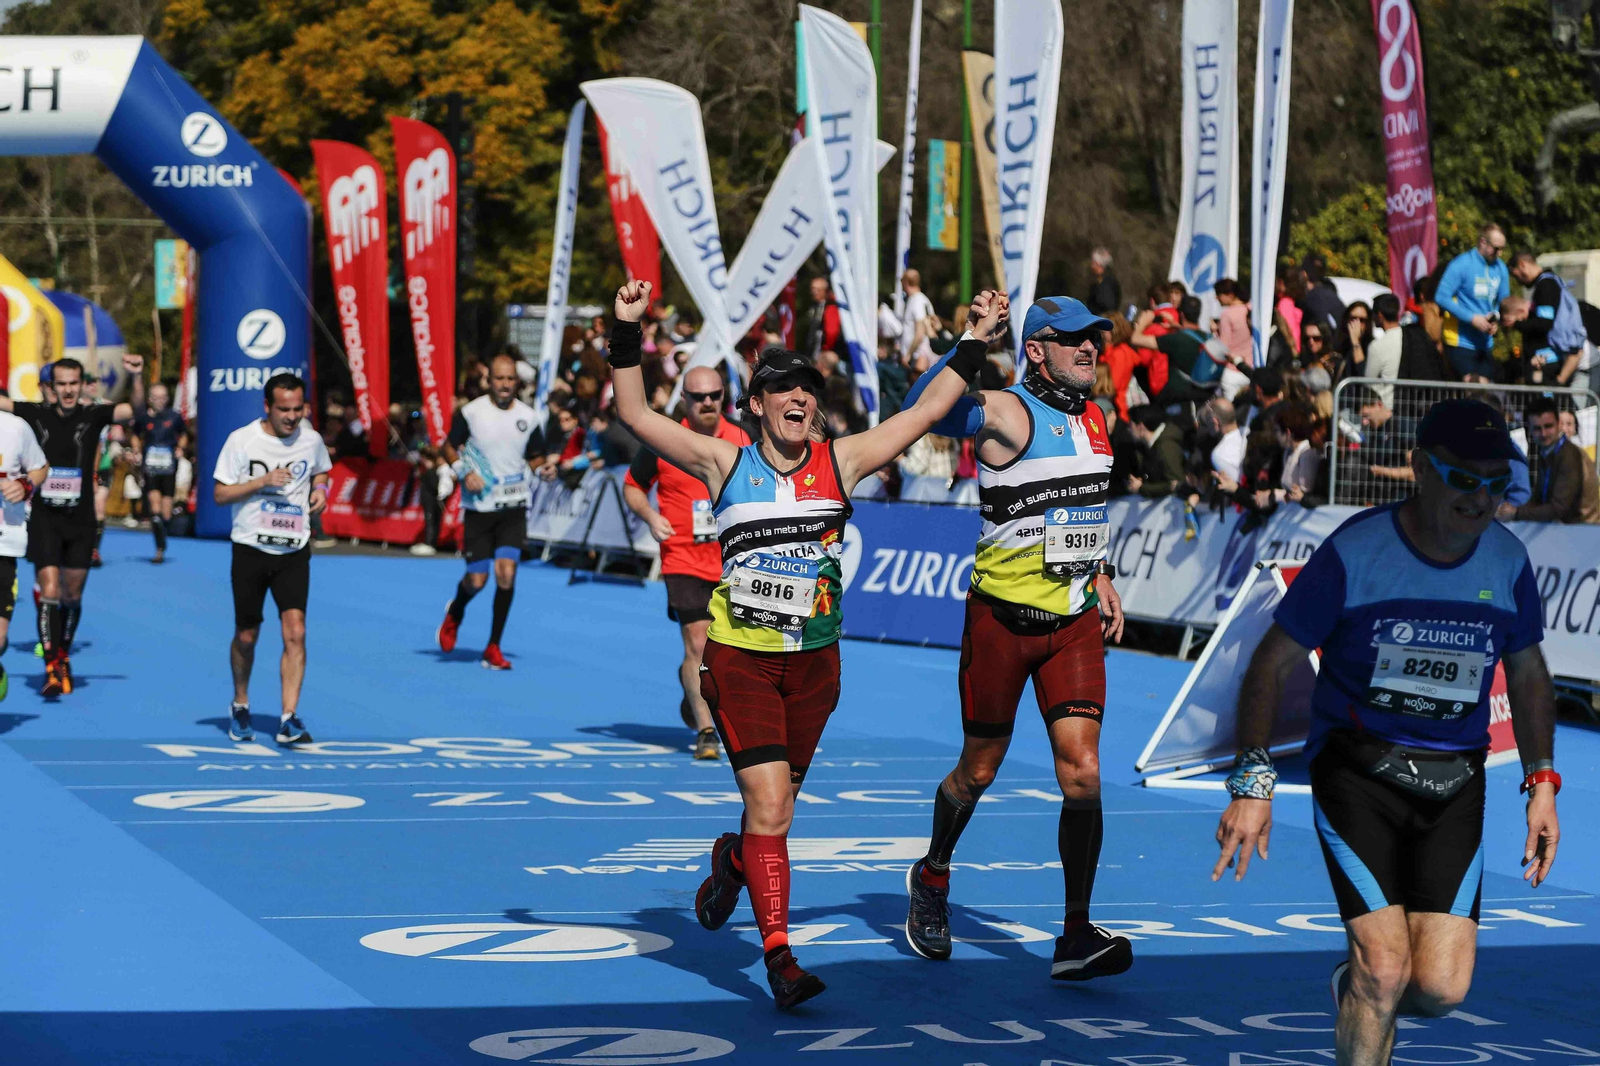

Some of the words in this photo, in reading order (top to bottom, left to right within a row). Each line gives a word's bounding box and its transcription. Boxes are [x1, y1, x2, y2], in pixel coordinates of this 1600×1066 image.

[152, 164, 253, 189] ZURICH
[209, 366, 303, 393] ZURI
[1007, 498, 1026, 516] Del
[1026, 488, 1059, 506] sueño
[1060, 488, 1067, 497] a
[1068, 486, 1077, 496] la
[1078, 482, 1100, 495] meta
[1071, 510, 1104, 521] ZURICH
[728, 531, 753, 547] sueño
[762, 528, 772, 537] la
[773, 525, 798, 535] meta
[799, 521, 826, 533] Team
[1064, 532, 1097, 549] 9319
[762, 558, 808, 574] ZURICH
[751, 578, 795, 600] 9816
[1417, 628, 1476, 647] ZURICH
[1402, 657, 1459, 683] 8269
[1415, 685, 1438, 695] HARO
[197, 762, 593, 772] AYUNTAMIENTO
[609, 761, 678, 769] DE
[523, 864, 701, 875] new
